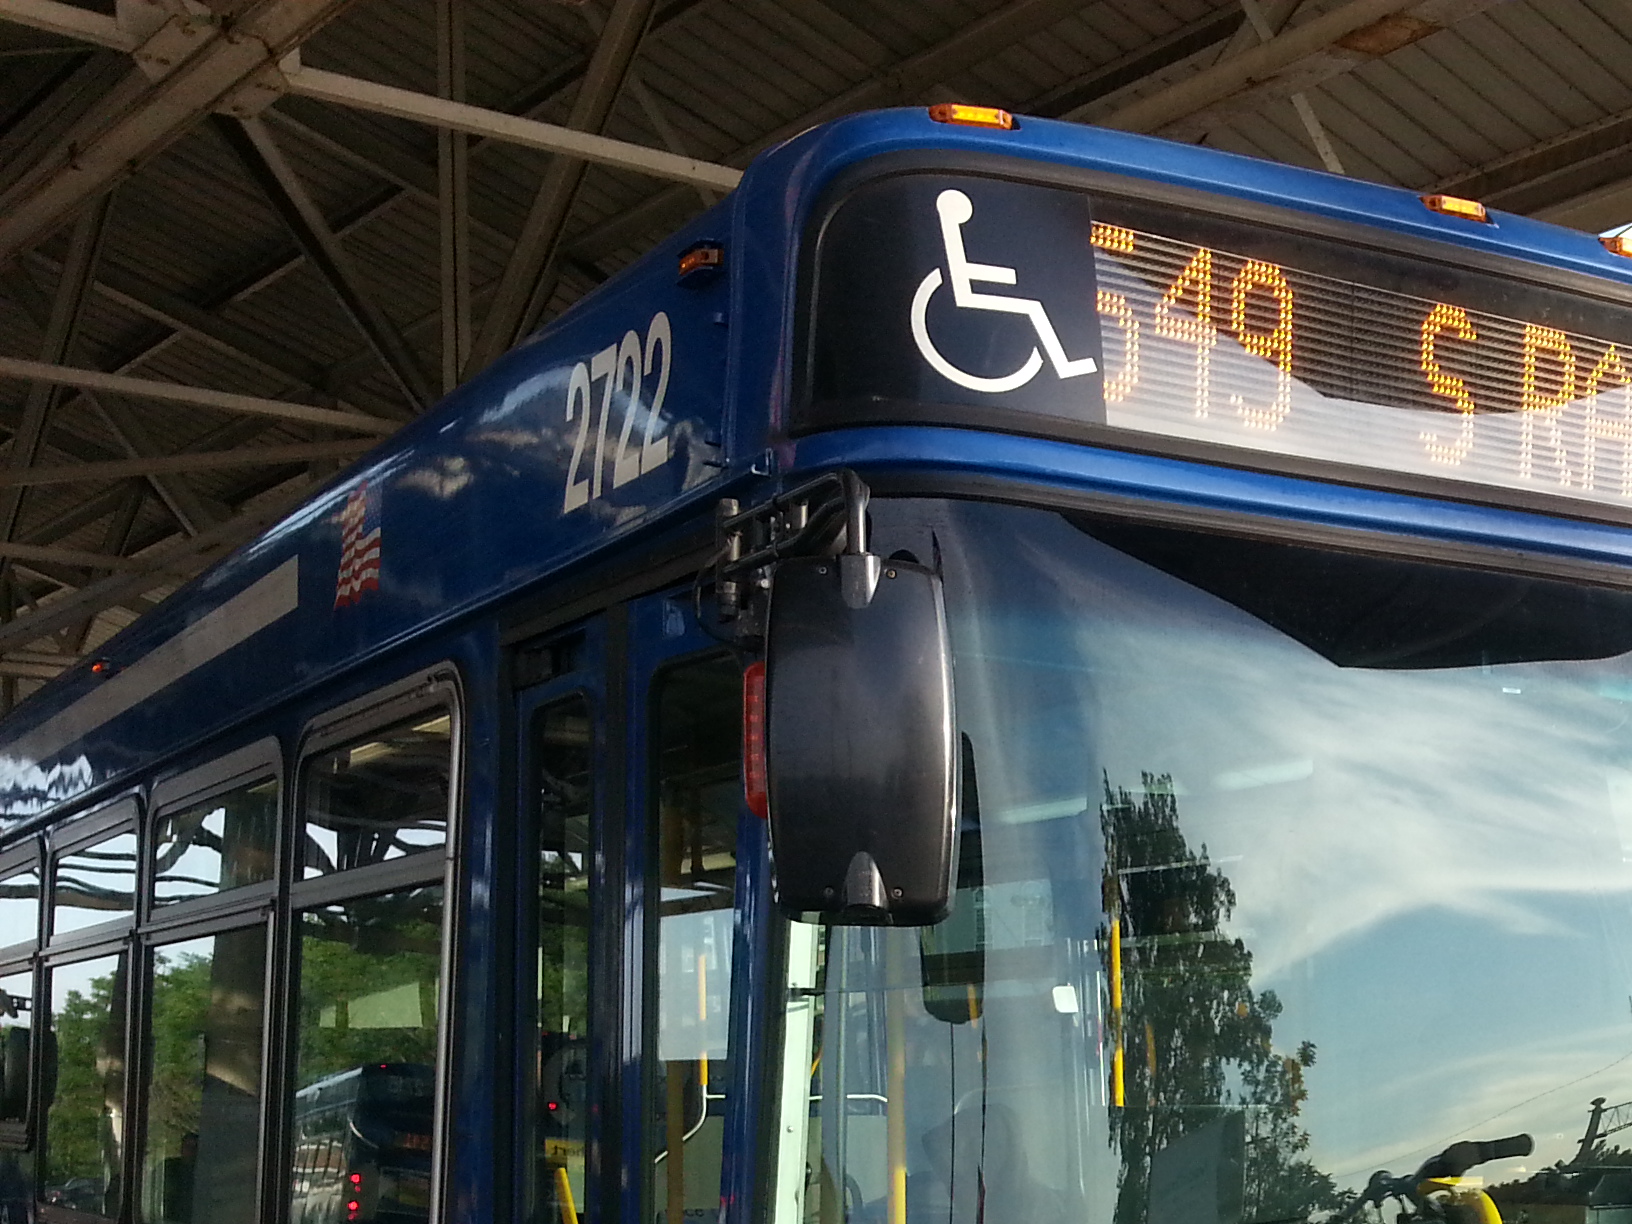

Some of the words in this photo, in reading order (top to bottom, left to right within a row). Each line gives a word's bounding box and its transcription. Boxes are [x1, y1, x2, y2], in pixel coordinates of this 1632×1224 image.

[564, 311, 671, 514] 2722
[1090, 221, 1293, 431] 549
[1420, 303, 1477, 465] S
